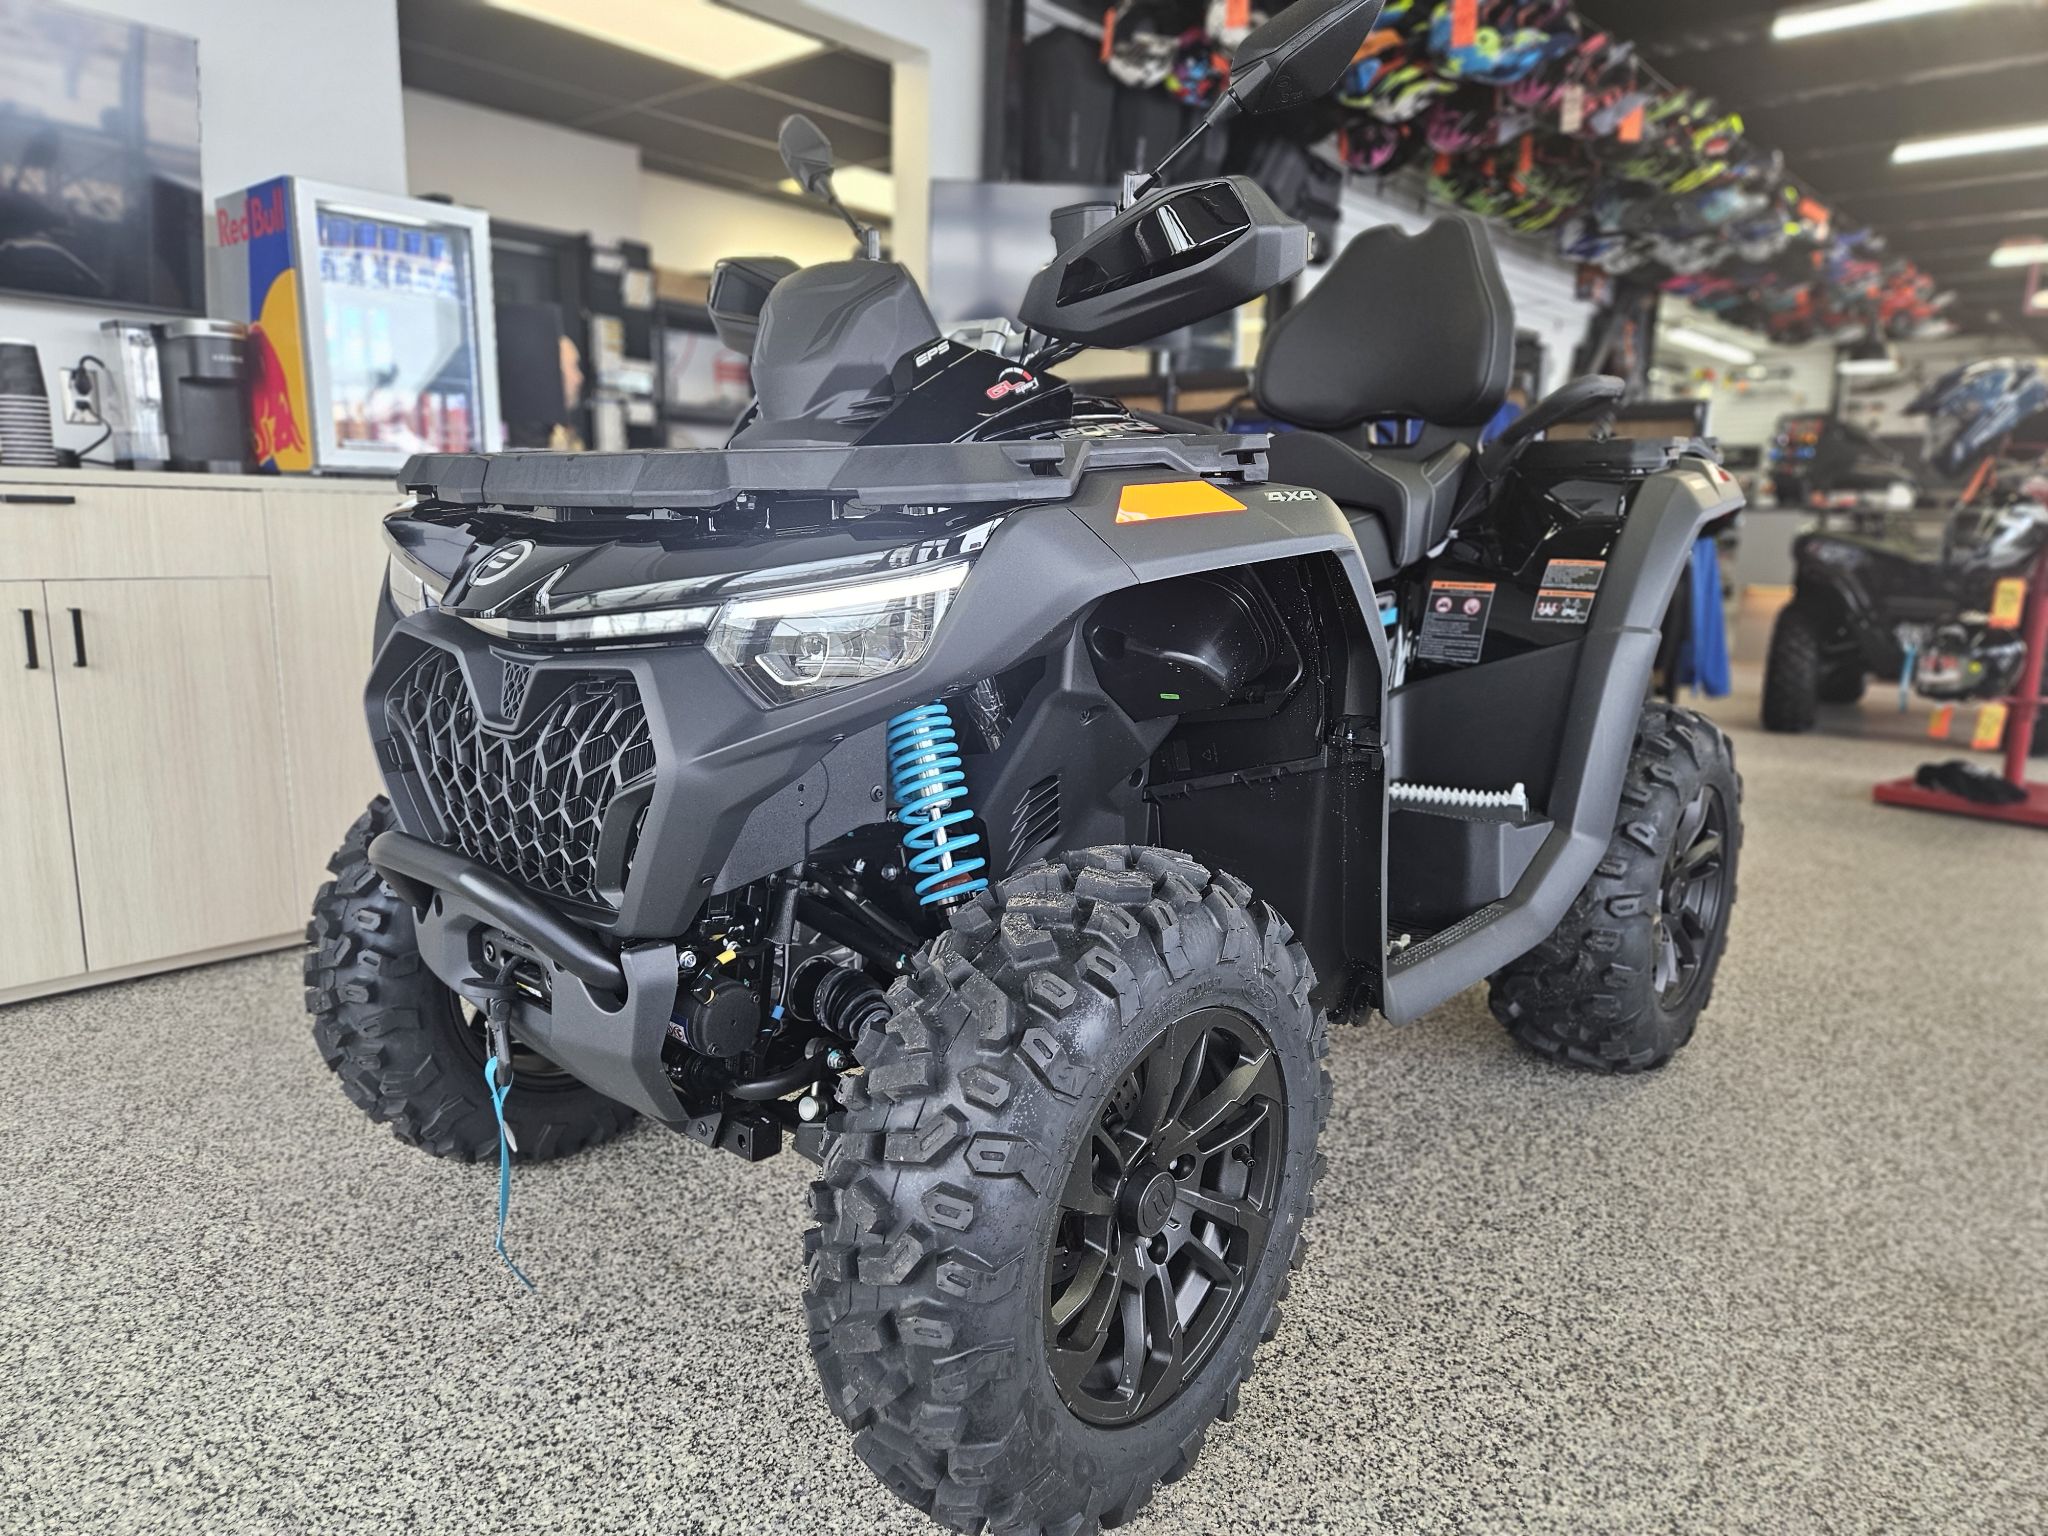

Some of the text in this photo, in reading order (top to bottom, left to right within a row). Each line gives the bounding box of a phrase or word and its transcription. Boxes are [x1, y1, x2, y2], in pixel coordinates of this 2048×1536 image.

[216, 186, 286, 247] Red Bull
[915, 340, 950, 368] EPS
